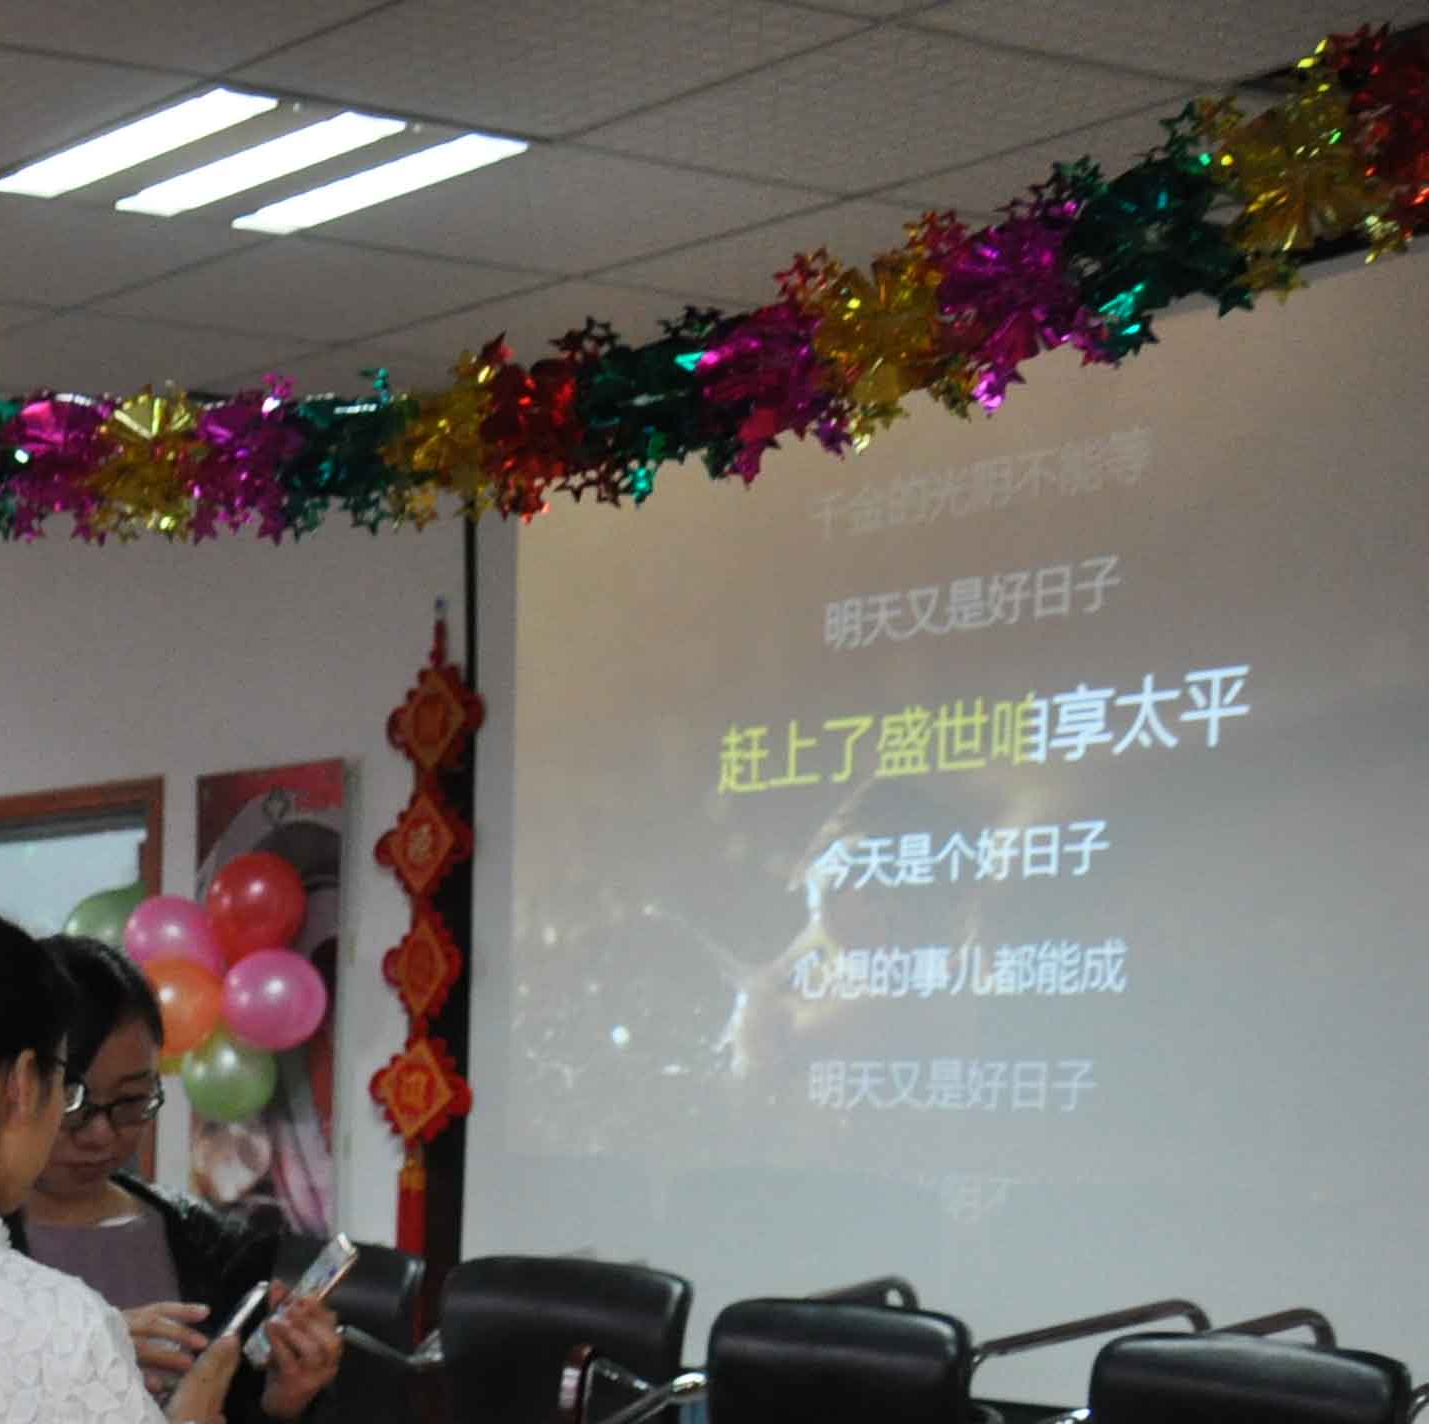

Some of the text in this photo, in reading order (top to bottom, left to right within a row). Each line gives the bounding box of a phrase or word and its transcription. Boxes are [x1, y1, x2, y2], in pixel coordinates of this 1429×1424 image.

[824, 555, 1121, 652] 明天又是好日子
[716, 664, 1252, 796] 赶上了盛世咱享太平
[814, 819, 1111, 890] 今天是个好日子
[792, 937, 1129, 999] 心想的事儿都能成
[808, 1058, 1097, 1111] 明天又是好日子
